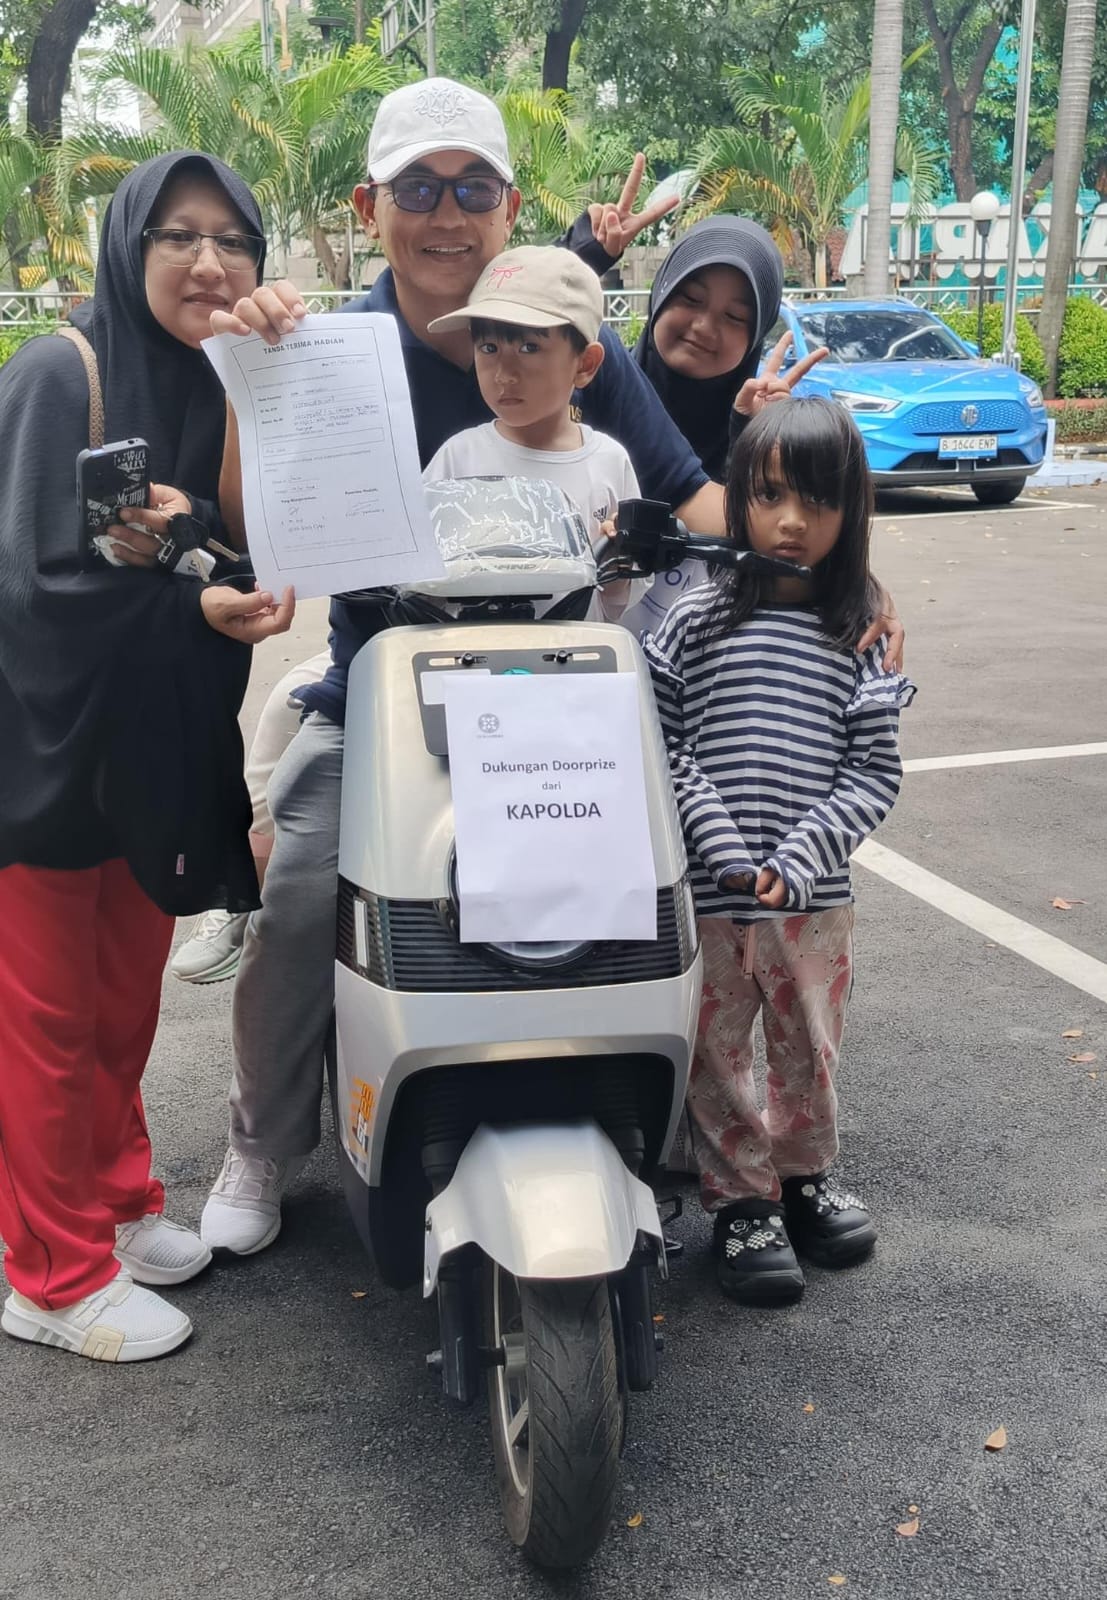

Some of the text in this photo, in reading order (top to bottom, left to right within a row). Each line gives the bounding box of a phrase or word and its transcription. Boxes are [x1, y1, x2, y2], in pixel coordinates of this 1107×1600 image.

[263, 337, 345, 355] TANDA TERIMA HADIAH
[942, 440, 949, 450] B
[978, 438, 996, 449] ENP
[482, 759, 616, 774] Dukungan Doorprize
[542, 780, 562, 790] dari
[506, 801, 603, 820] KAPOLDA
